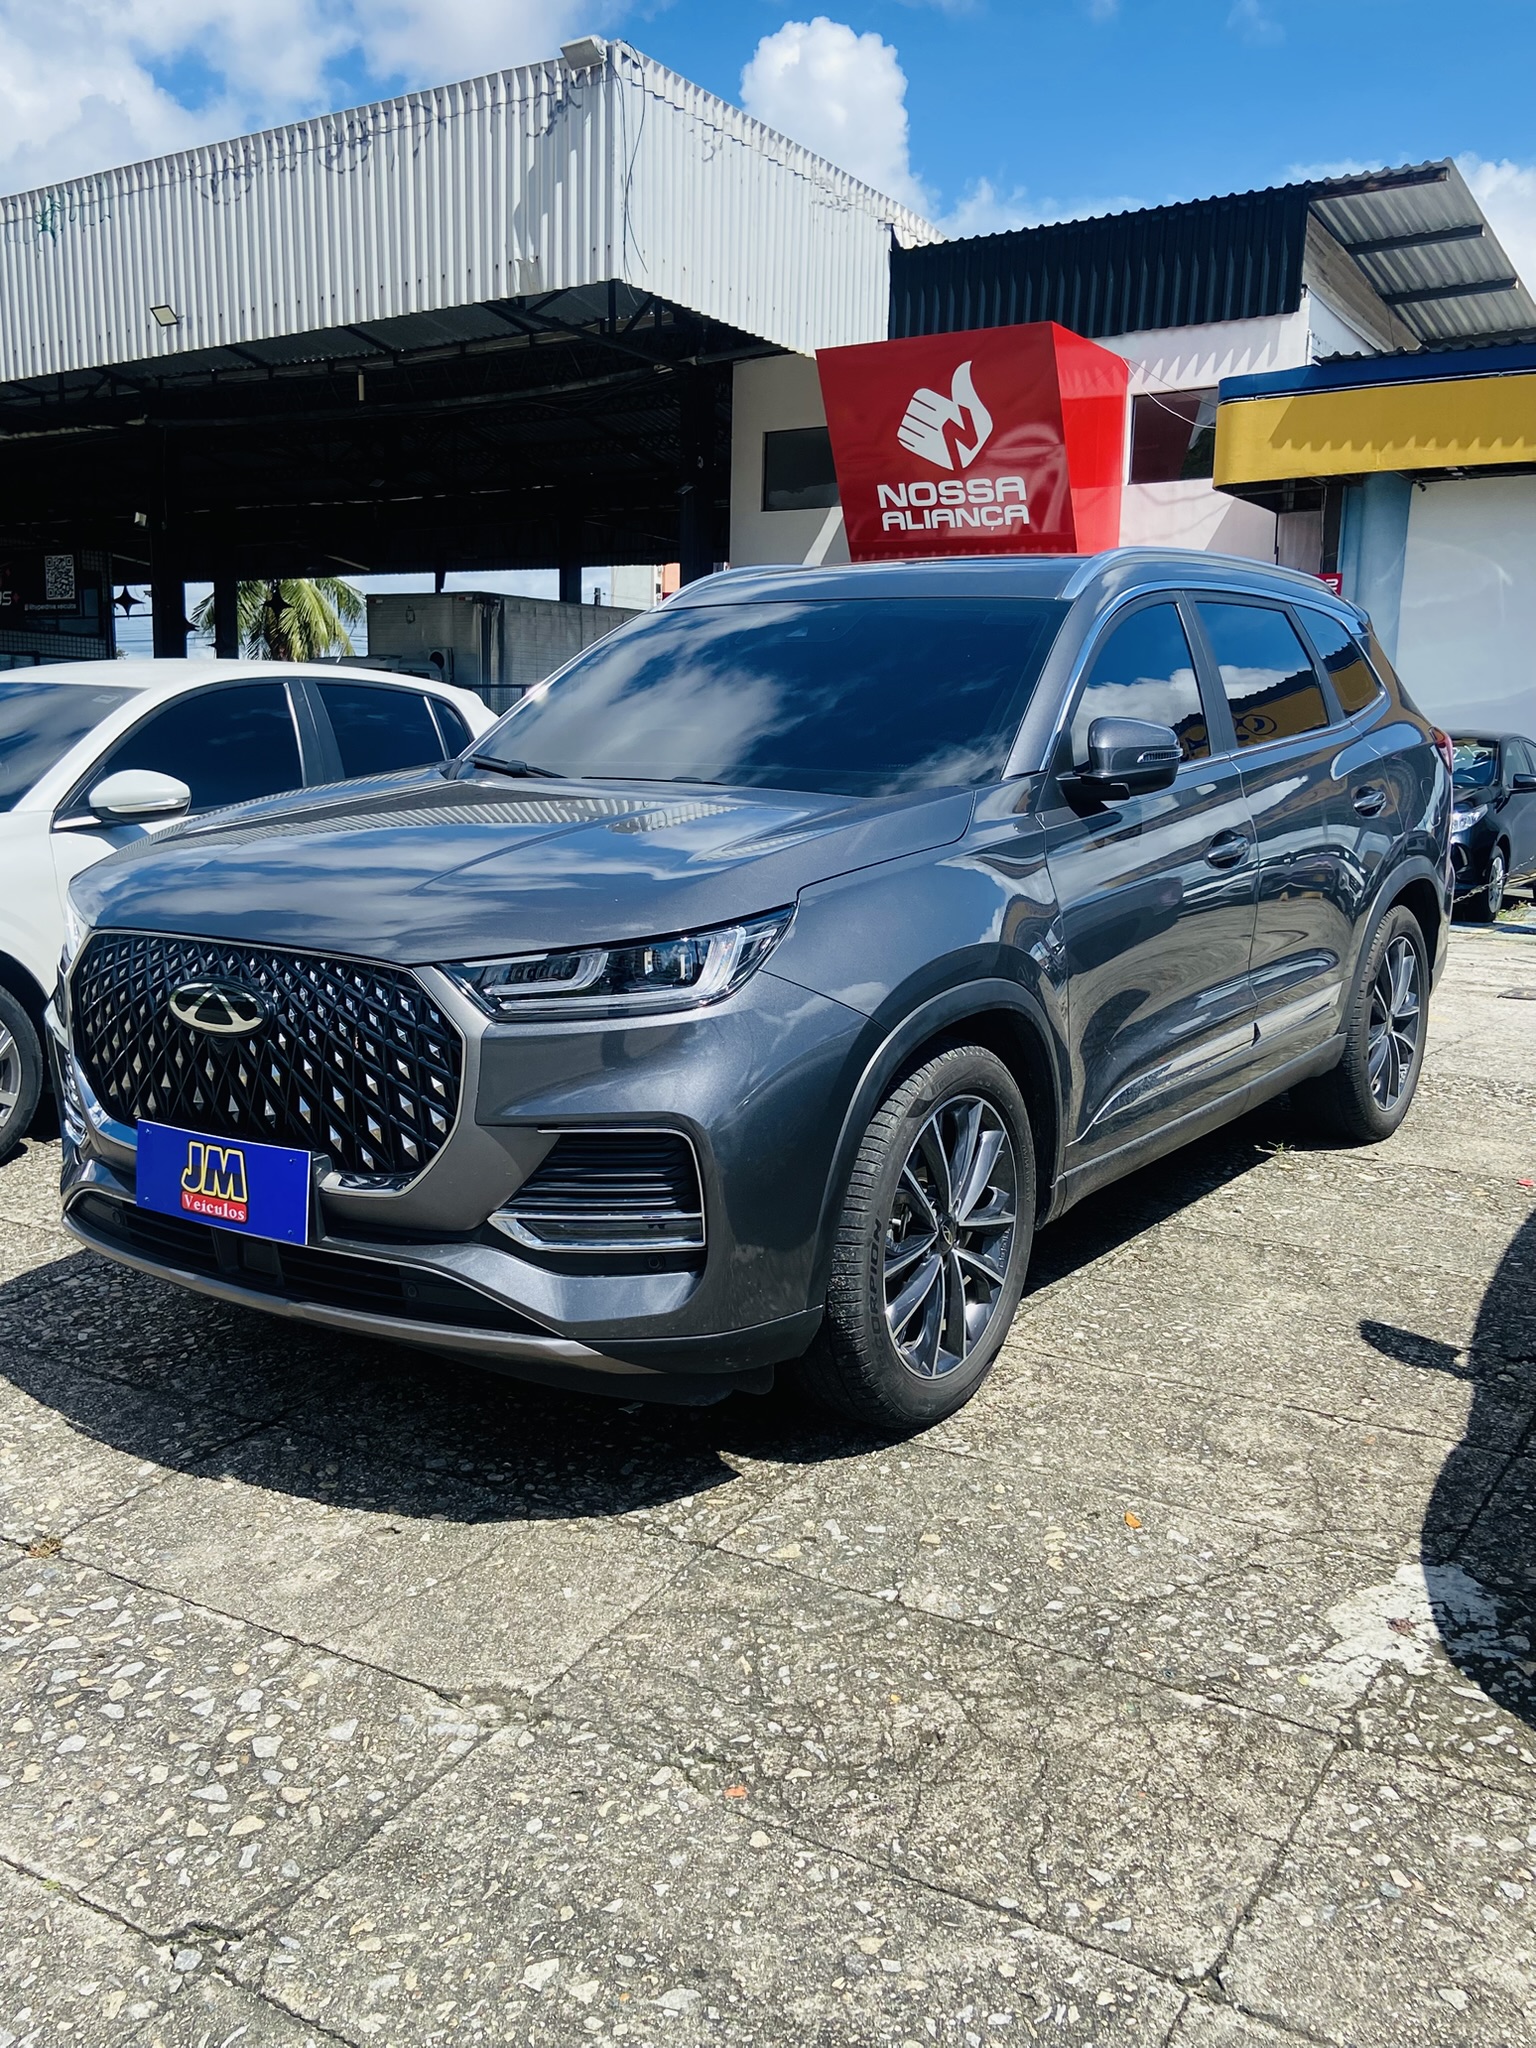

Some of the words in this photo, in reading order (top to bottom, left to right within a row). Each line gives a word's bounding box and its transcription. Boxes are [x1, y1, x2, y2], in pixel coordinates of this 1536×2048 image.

[877, 476, 1027, 509] NOSSA
[881, 504, 1030, 531] ALIANÇA
[181, 1141, 248, 1203] JM
